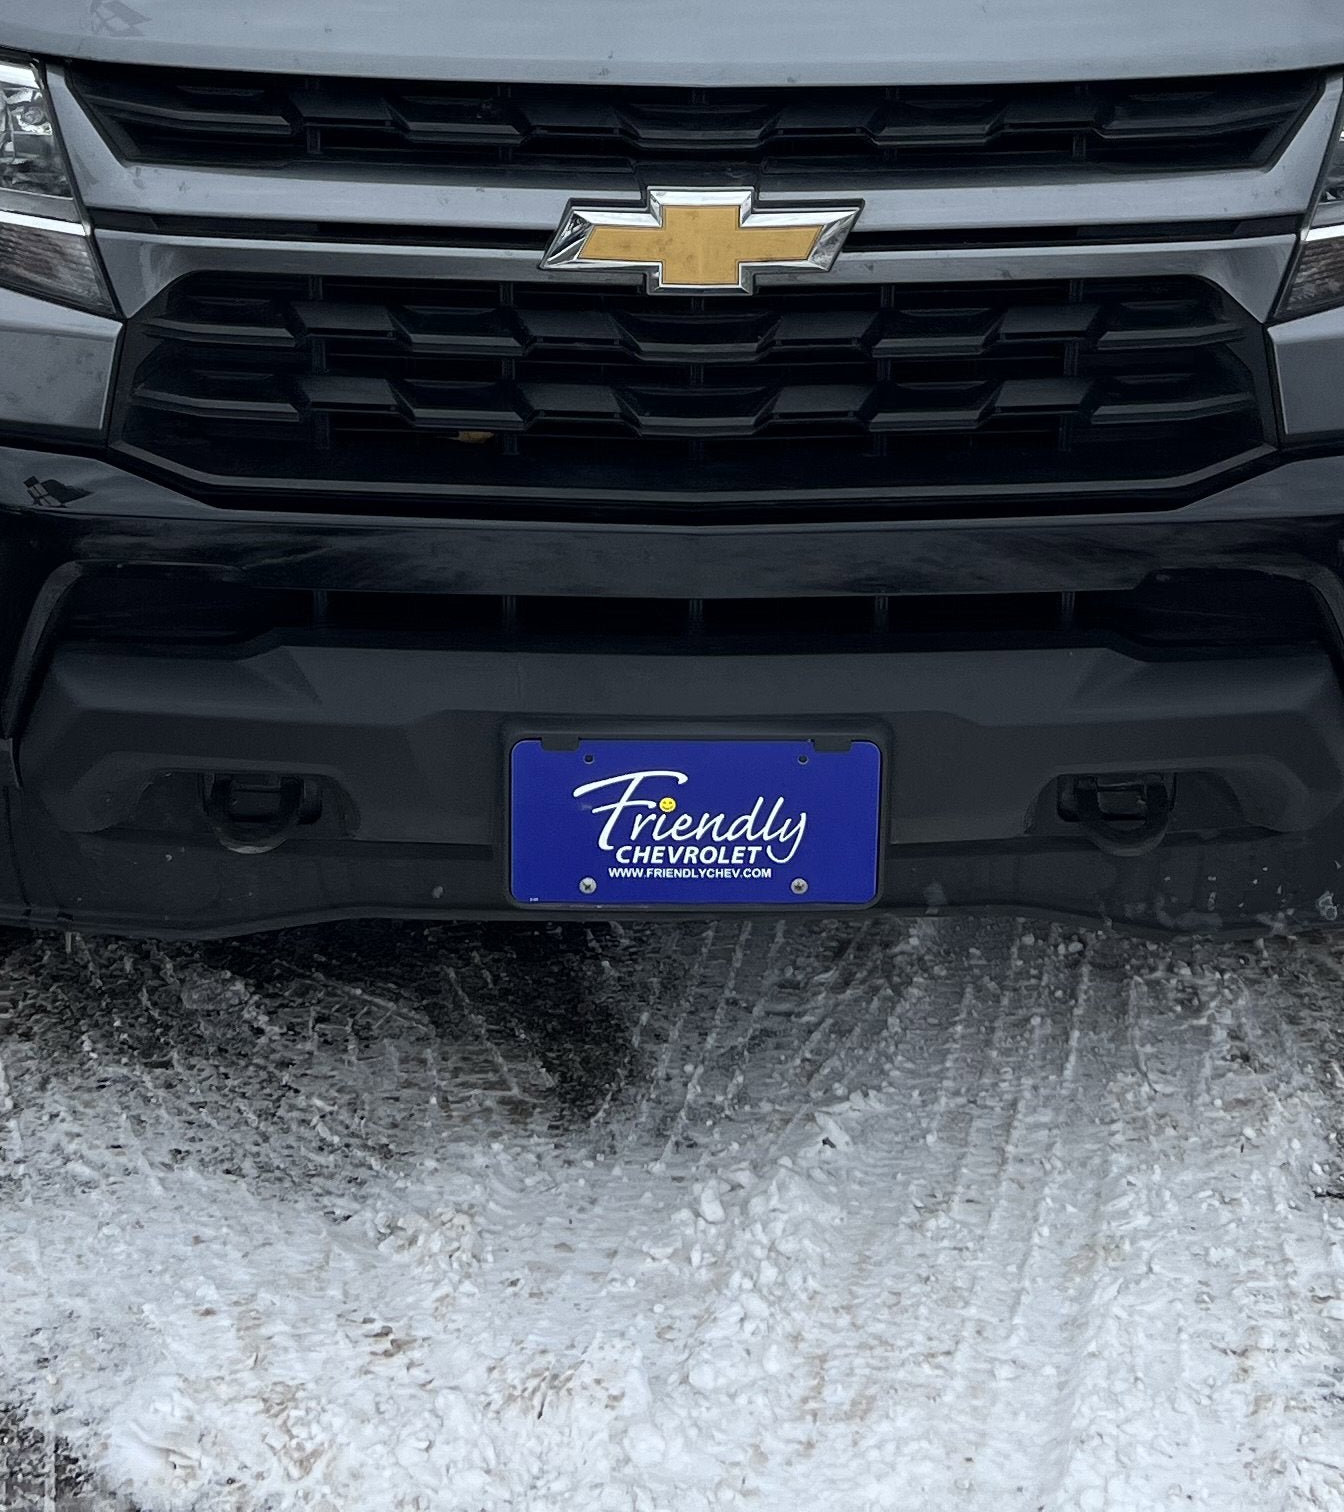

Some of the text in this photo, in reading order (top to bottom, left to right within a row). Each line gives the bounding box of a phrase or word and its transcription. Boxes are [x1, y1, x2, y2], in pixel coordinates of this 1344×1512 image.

[572, 770, 807, 864] Friendly
[615, 845, 762, 864] CHEVROLET
[608, 867, 772, 879] WWW.FRIENDLYCHEV.COM
